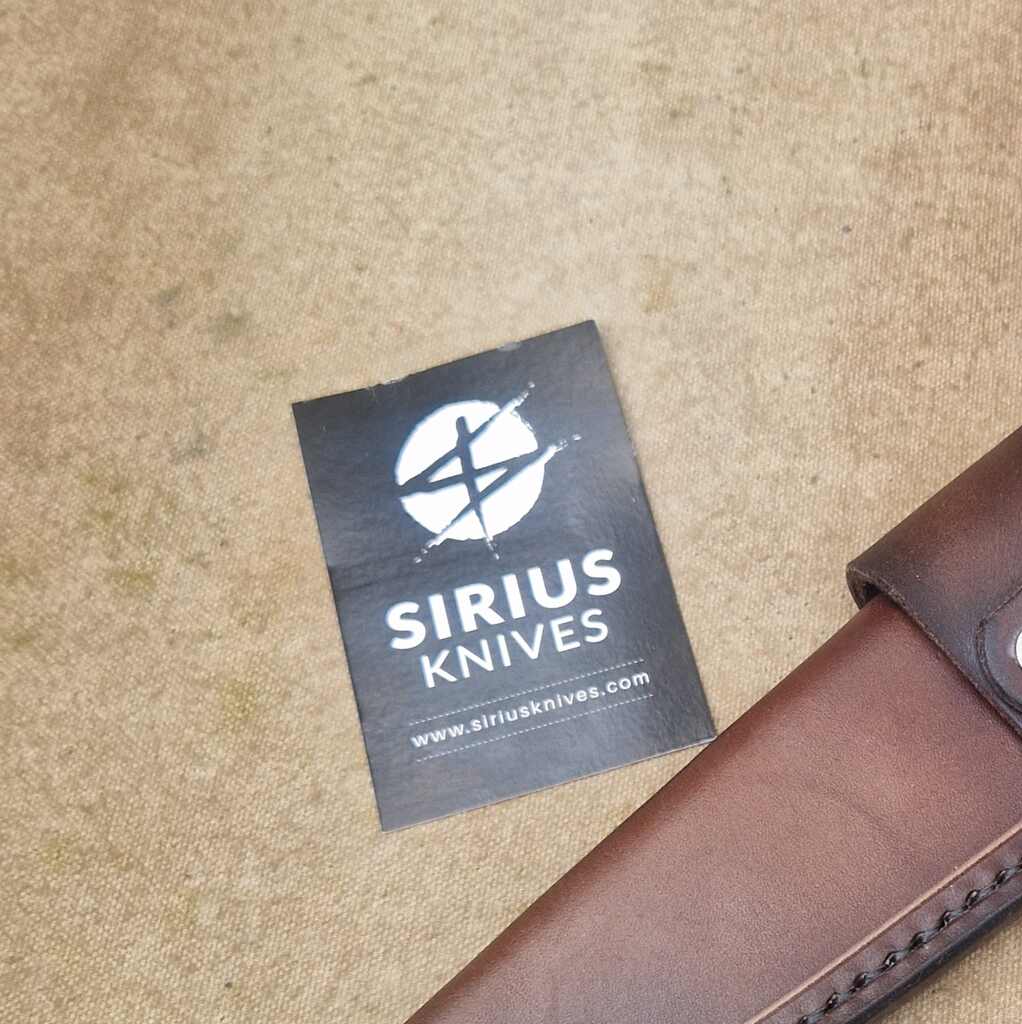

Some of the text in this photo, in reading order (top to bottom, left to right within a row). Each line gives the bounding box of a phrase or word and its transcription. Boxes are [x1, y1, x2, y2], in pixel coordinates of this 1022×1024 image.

[385, 548, 622, 650] SIRIUS
[420, 608, 609, 688] KNIVES
[410, 671, 651, 748] www.siriusknives.com
